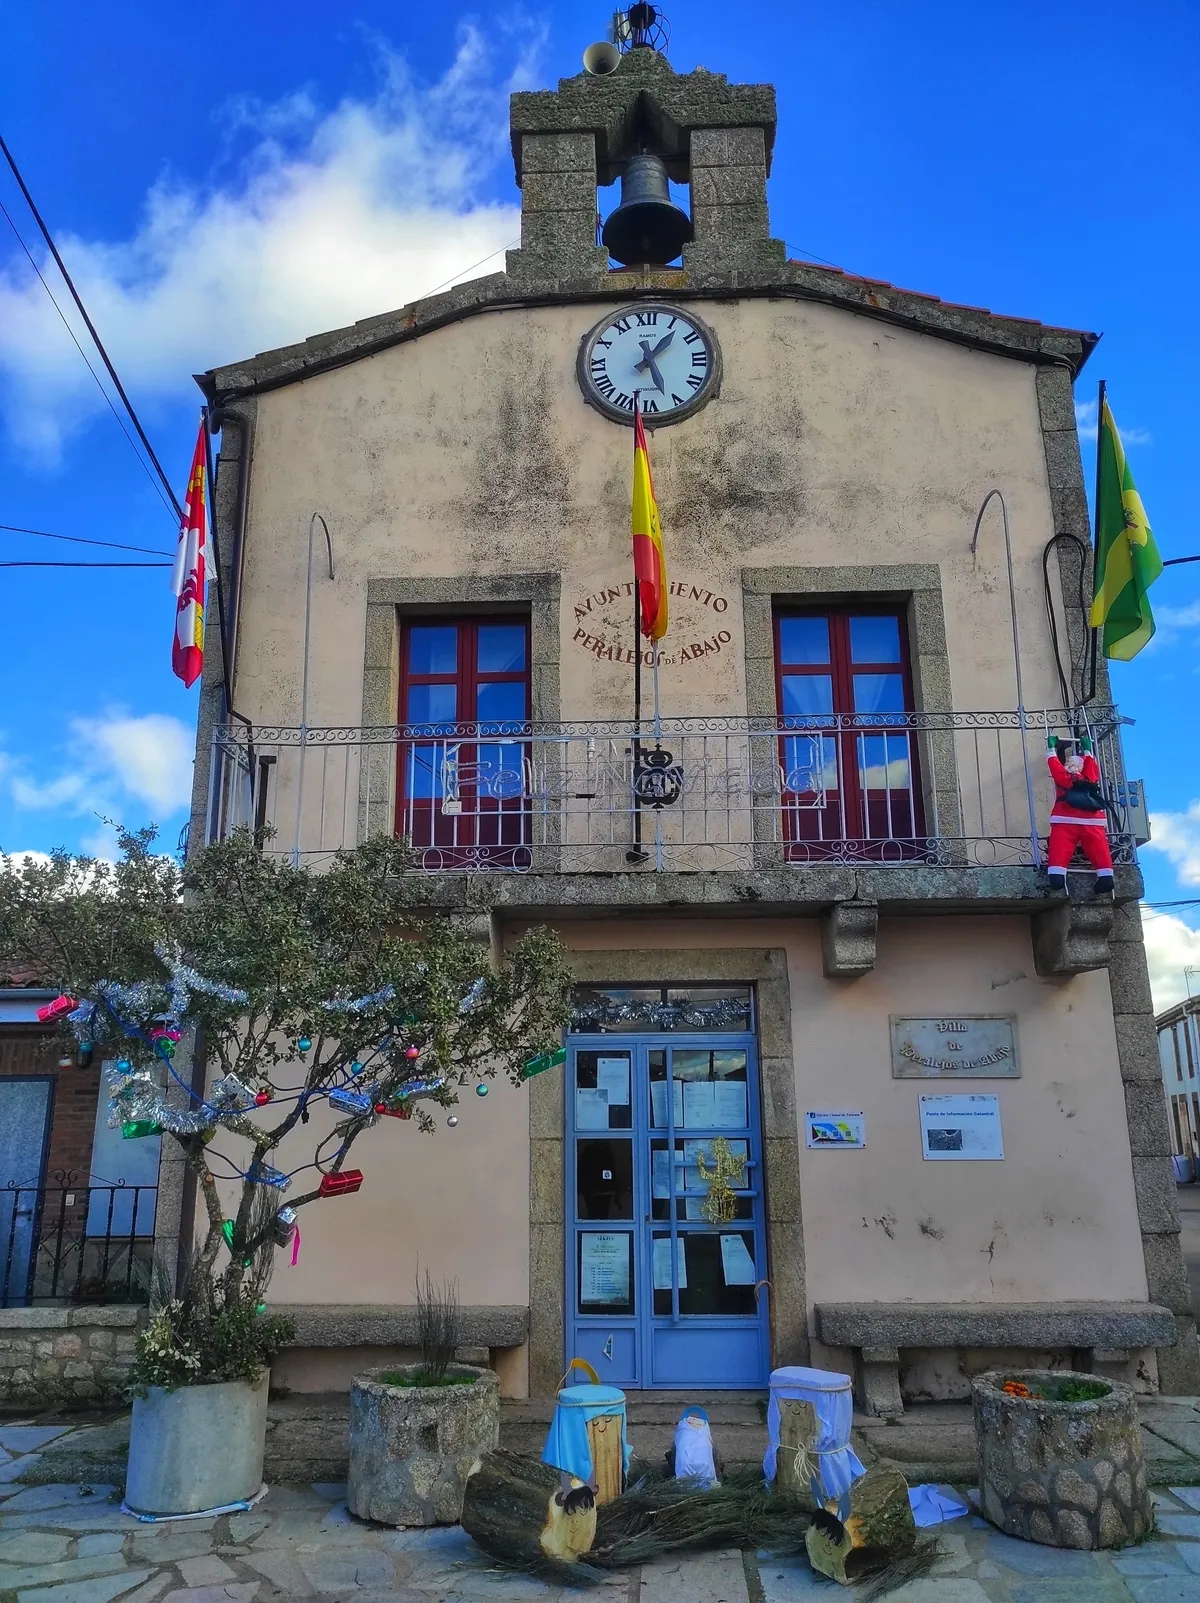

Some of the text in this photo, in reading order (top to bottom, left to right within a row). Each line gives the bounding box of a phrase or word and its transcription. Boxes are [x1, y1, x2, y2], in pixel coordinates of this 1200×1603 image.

[613, 318, 632, 335] XI
[635, 312, 658, 326] XII
[597, 337, 613, 349] X
[683, 330, 700, 346] II
[591, 357, 606, 373] IX
[691, 351, 707, 367] III
[643, 399, 660, 413] VI
[573, 581, 728, 624] AYUNTIENTO
[936, 1020, 968, 1033] Villa
[948, 1040, 962, 1051] de
[962, 1059, 977, 1069] de
[979, 1044, 1011, 1066] Abajo
